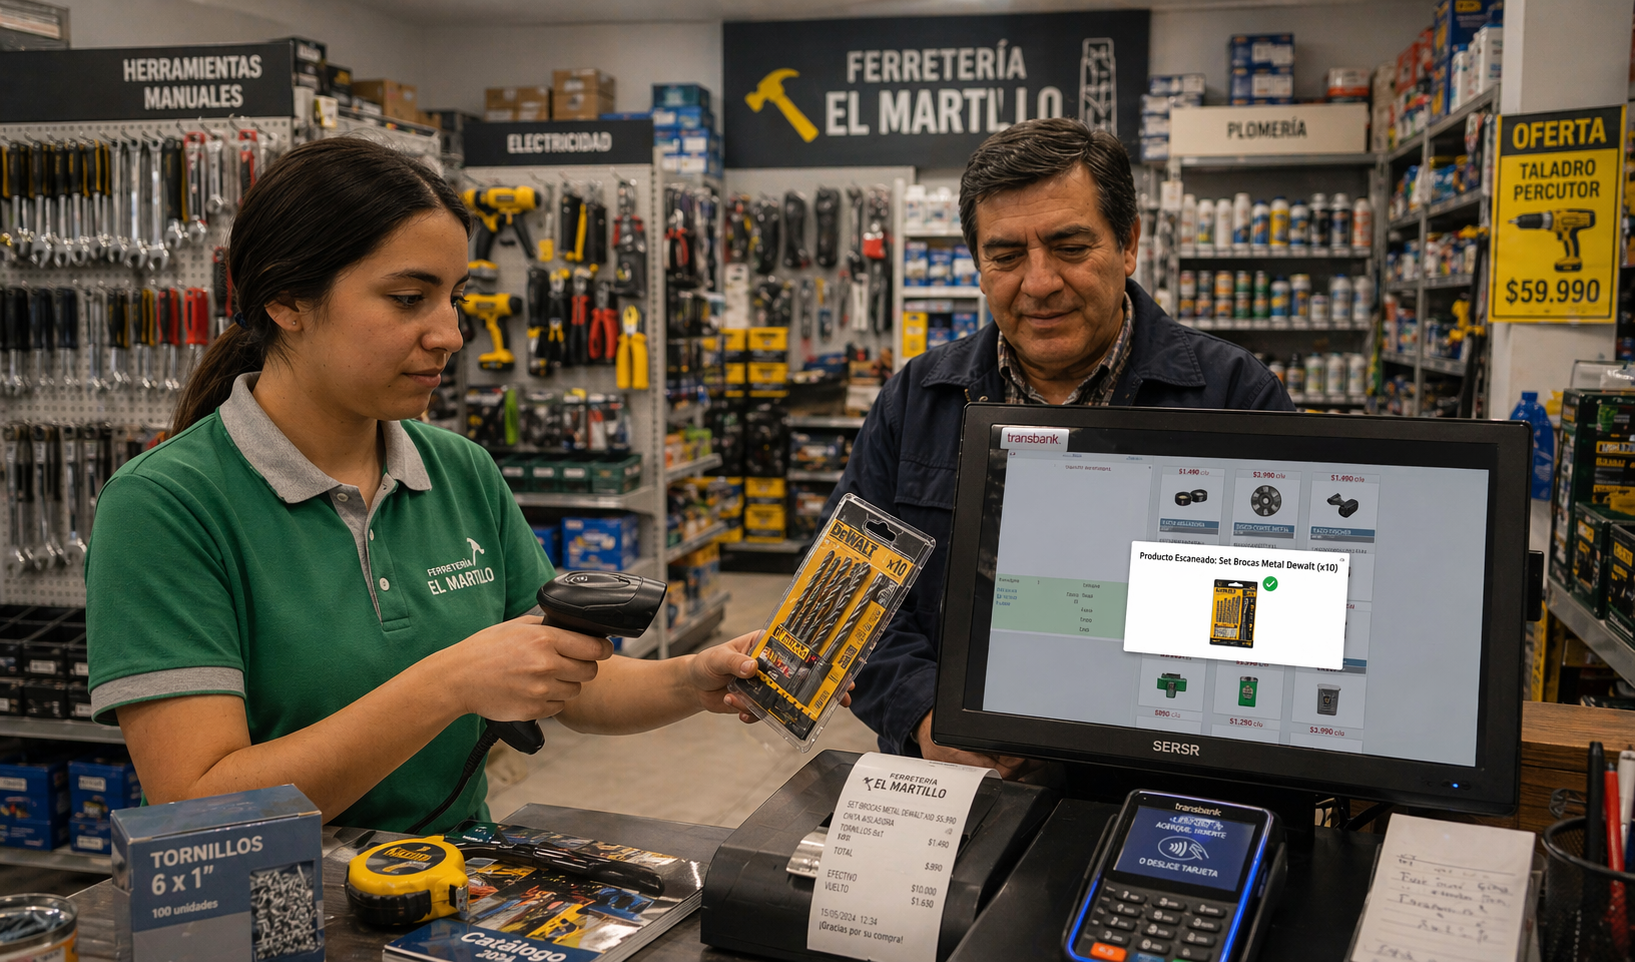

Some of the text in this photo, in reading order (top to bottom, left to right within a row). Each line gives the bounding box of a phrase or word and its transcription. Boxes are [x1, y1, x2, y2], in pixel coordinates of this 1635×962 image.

[123, 54, 263, 82] HERRAMIENTAS
[846, 38, 1028, 84] FERRETERÍA
[144, 84, 244, 110] MANUALES
[825, 90, 870, 136] EL
[1226, 116, 1308, 140] PLOMERÍA
[1512, 117, 1607, 150] OFERTA
[507, 132, 612, 154] ELECTRICIDAD
[1519, 158, 1596, 180] TALADRO
[1513, 181, 1600, 202] PERCUTOR
[1505, 277, 1600, 306] $59.990
[886, 559, 908, 578] x10
[1139, 552, 1173, 562] Producto
[1174, 554, 1217, 564] Escaneado:
[1218, 557, 1232, 566] Set
[1233, 558, 1260, 567] Brocas
[1261, 559, 1285, 569] Metal
[1316, 562, 1339, 573] (x10)
[427, 579, 447, 596] EL
[1152, 740, 1200, 757] SERSR
[873, 778, 947, 799] EL MARTILLO
[889, 772, 938, 786] FERRETERÍA
[1175, 803, 1222, 817] transbank
[150, 835, 264, 869] TORNILLOS
[833, 846, 853, 857] TOTAL
[827, 869, 858, 882] EFECTIVO
[1139, 857, 1219, 878] O DESLICE TARJETA
[151, 873, 167, 896] 6
[172, 874, 186, 893] x
[825, 881, 850, 893] VUELTO
[152, 900, 219, 919] 100 unidades
[849, 927, 862, 937] por
[863, 930, 873, 938] su
[873, 932, 904, 945] compra!
[461, 932, 567, 962] Catálogo
